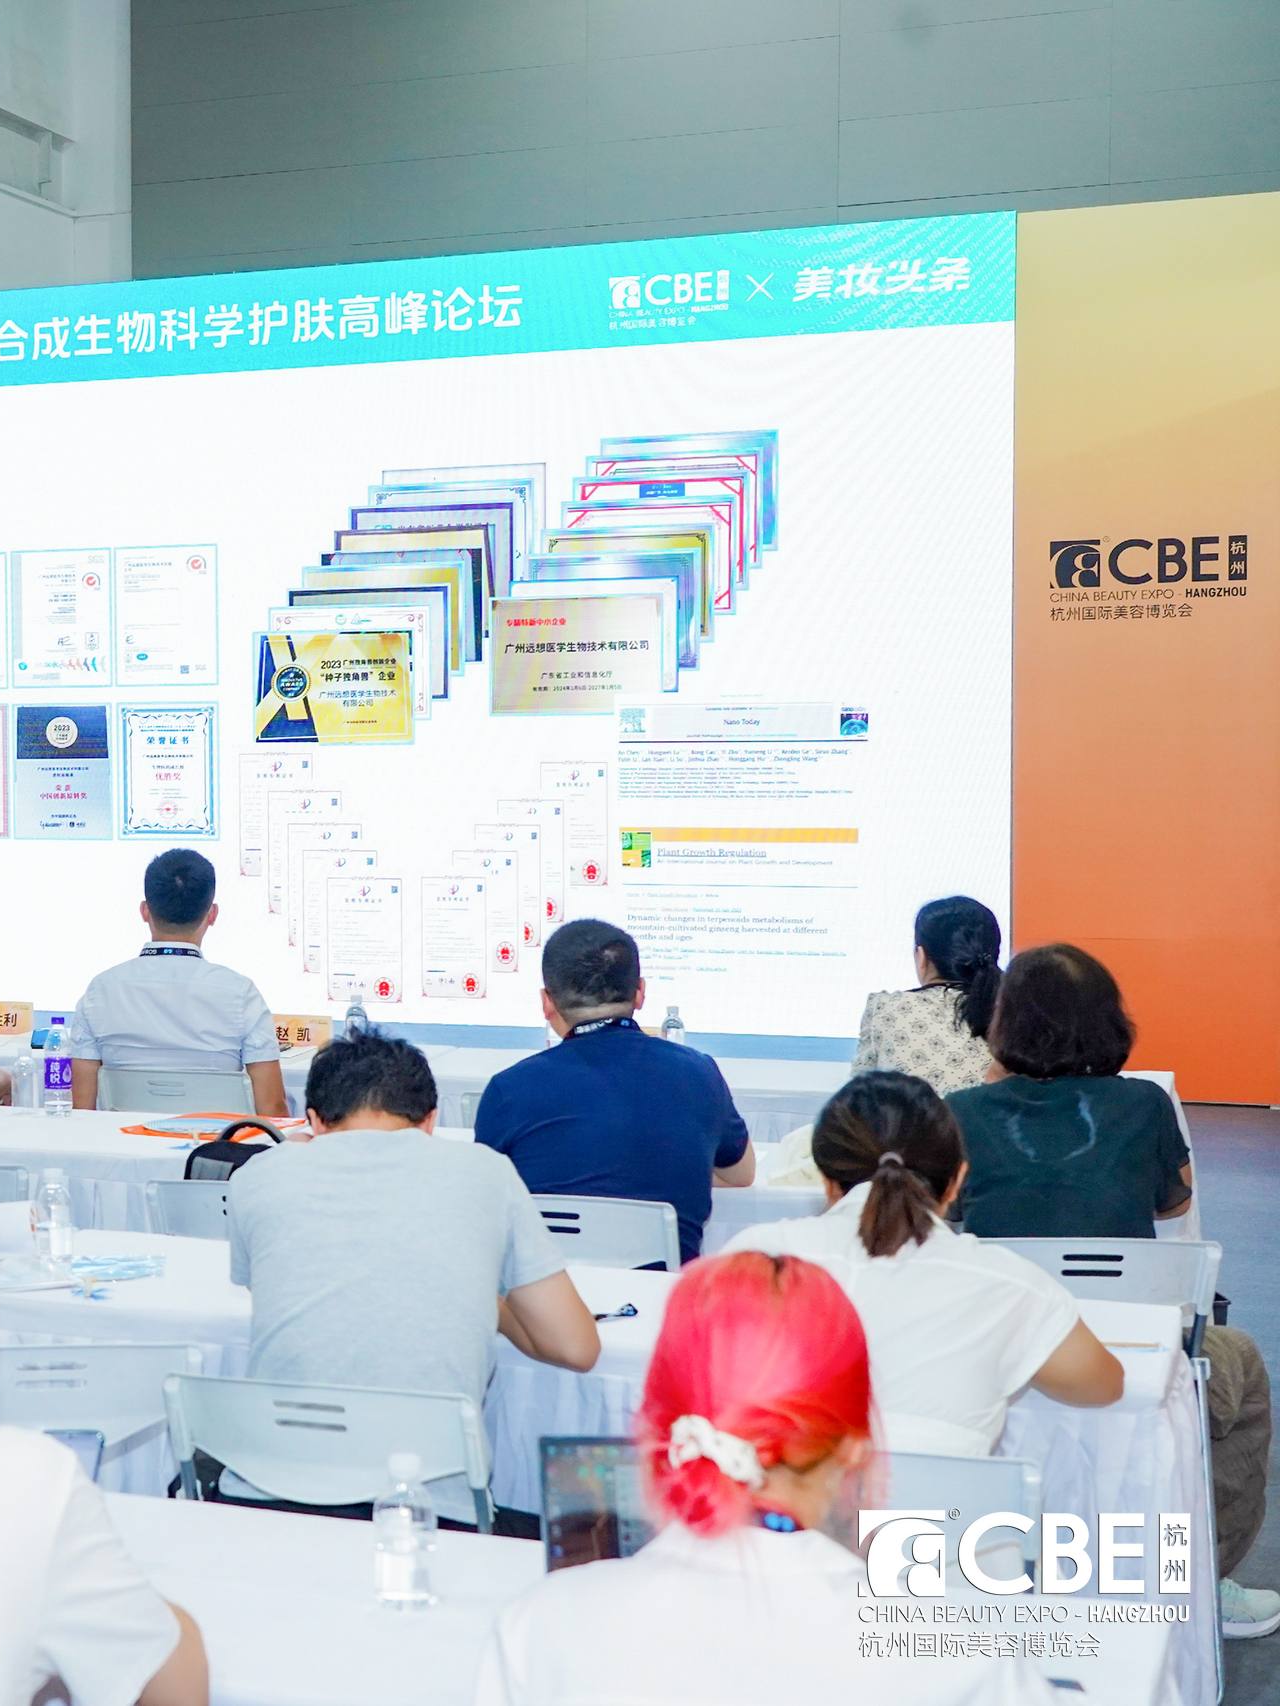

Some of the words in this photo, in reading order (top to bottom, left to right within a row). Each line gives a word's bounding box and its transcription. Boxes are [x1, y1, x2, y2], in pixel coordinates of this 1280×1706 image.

[791, 256, 972, 303] 美妆头条
[644, 271, 713, 306] CBE
[1108, 536, 1220, 585] CBE
[1229, 540, 1246, 575] 杭州
[1049, 591, 1090, 603] CHINA
[1093, 590, 1137, 602] BEAUTY
[1141, 588, 1174, 600] EXPO
[1185, 586, 1247, 598] HANGZHOU
[1049, 603, 1193, 622] 杭州国际美容博览会
[504, 640, 650, 654] 广州远想医学生物技术有限公司
[320, 660, 342, 670] 2023
[540, 670, 613, 680] 广东省工业和信息化厅
[742, 718, 761, 726] Today
[657, 848, 681, 857] Plant
[682, 848, 716, 857] Growth
[718, 848, 767, 859] Regulation
[626, 913, 661, 923] Dynamic
[663, 915, 696, 924] changes
[805, 916, 815, 924] of
[626, 924, 707, 932] mountain-cultivated
[741, 926, 782, 934] harvested
[792, 926, 829, 935] different
[659, 933, 674, 941] and
